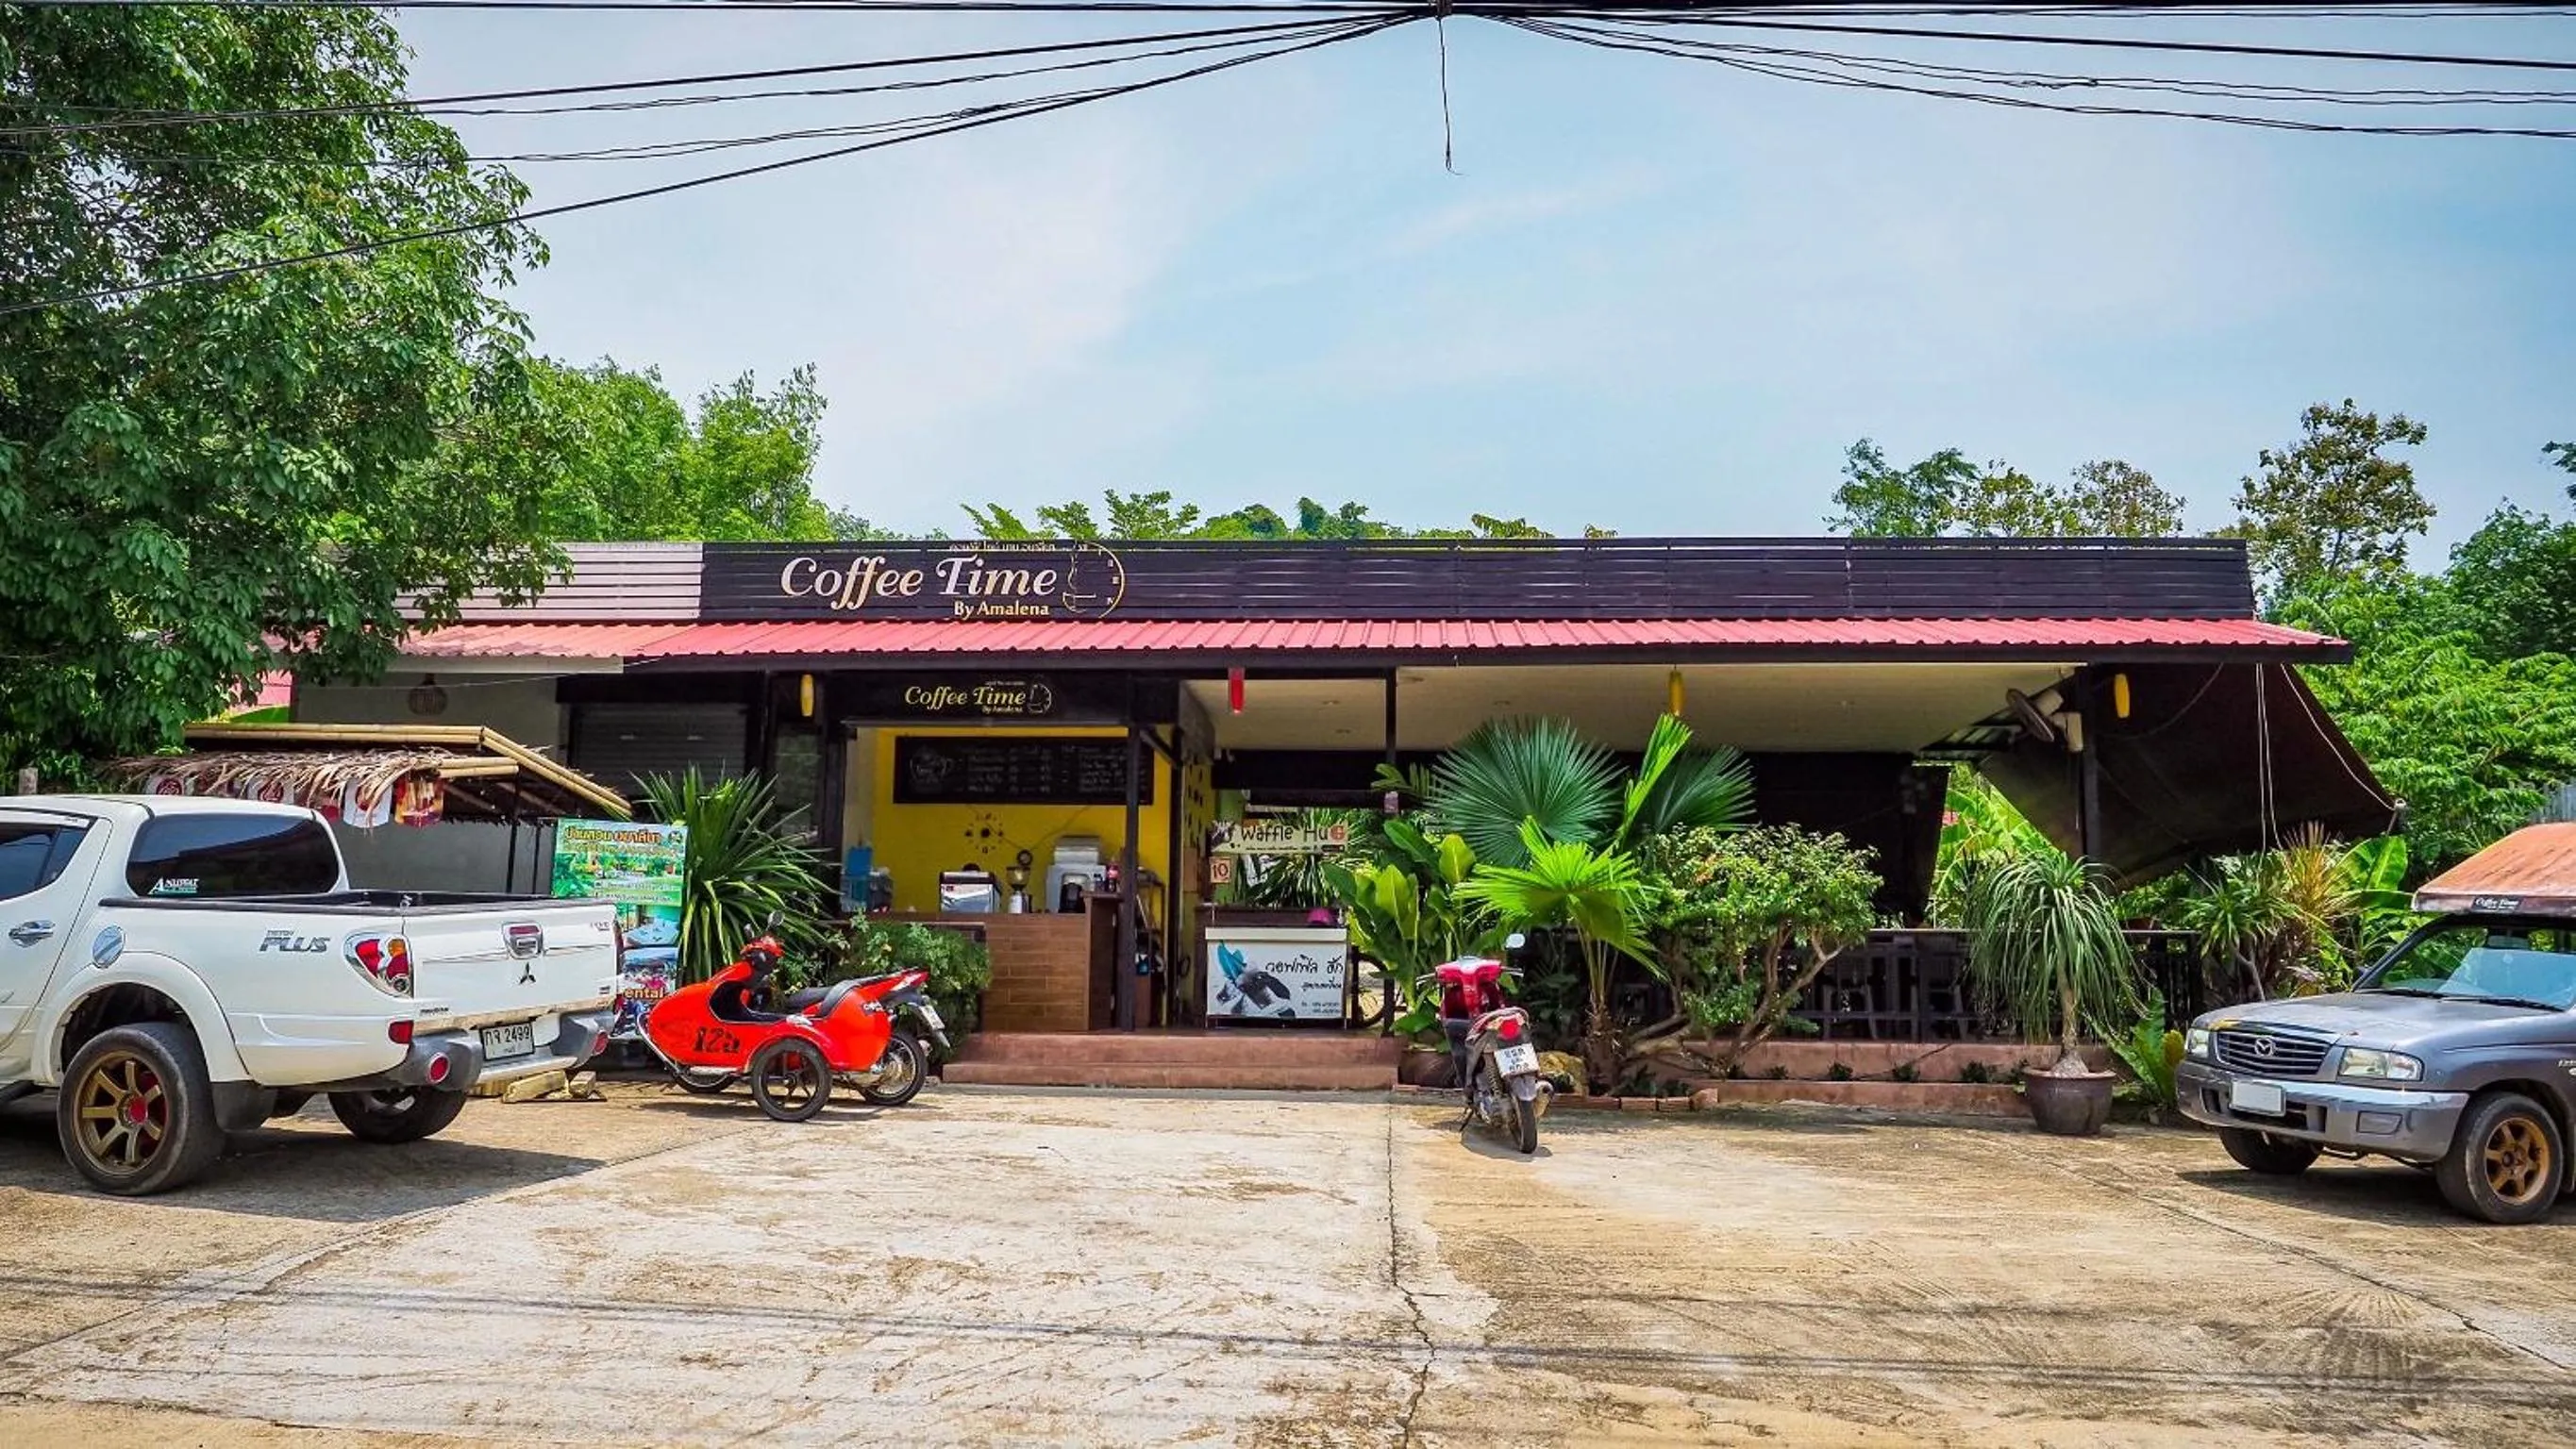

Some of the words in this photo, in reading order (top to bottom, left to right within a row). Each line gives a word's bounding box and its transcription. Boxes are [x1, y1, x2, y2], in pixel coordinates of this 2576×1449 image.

[780, 555, 925, 609] Coffee
[935, 553, 1057, 597] Time
[954, 601, 975, 618] By
[979, 601, 1049, 616] Amalena
[904, 686, 968, 710] Coffee
[973, 686, 1027, 706] Time
[1212, 862, 1229, 878] 10
[259, 937, 330, 953] PLUS
[625, 987, 664, 999] ental
[504, 1024, 530, 1043] 2499
